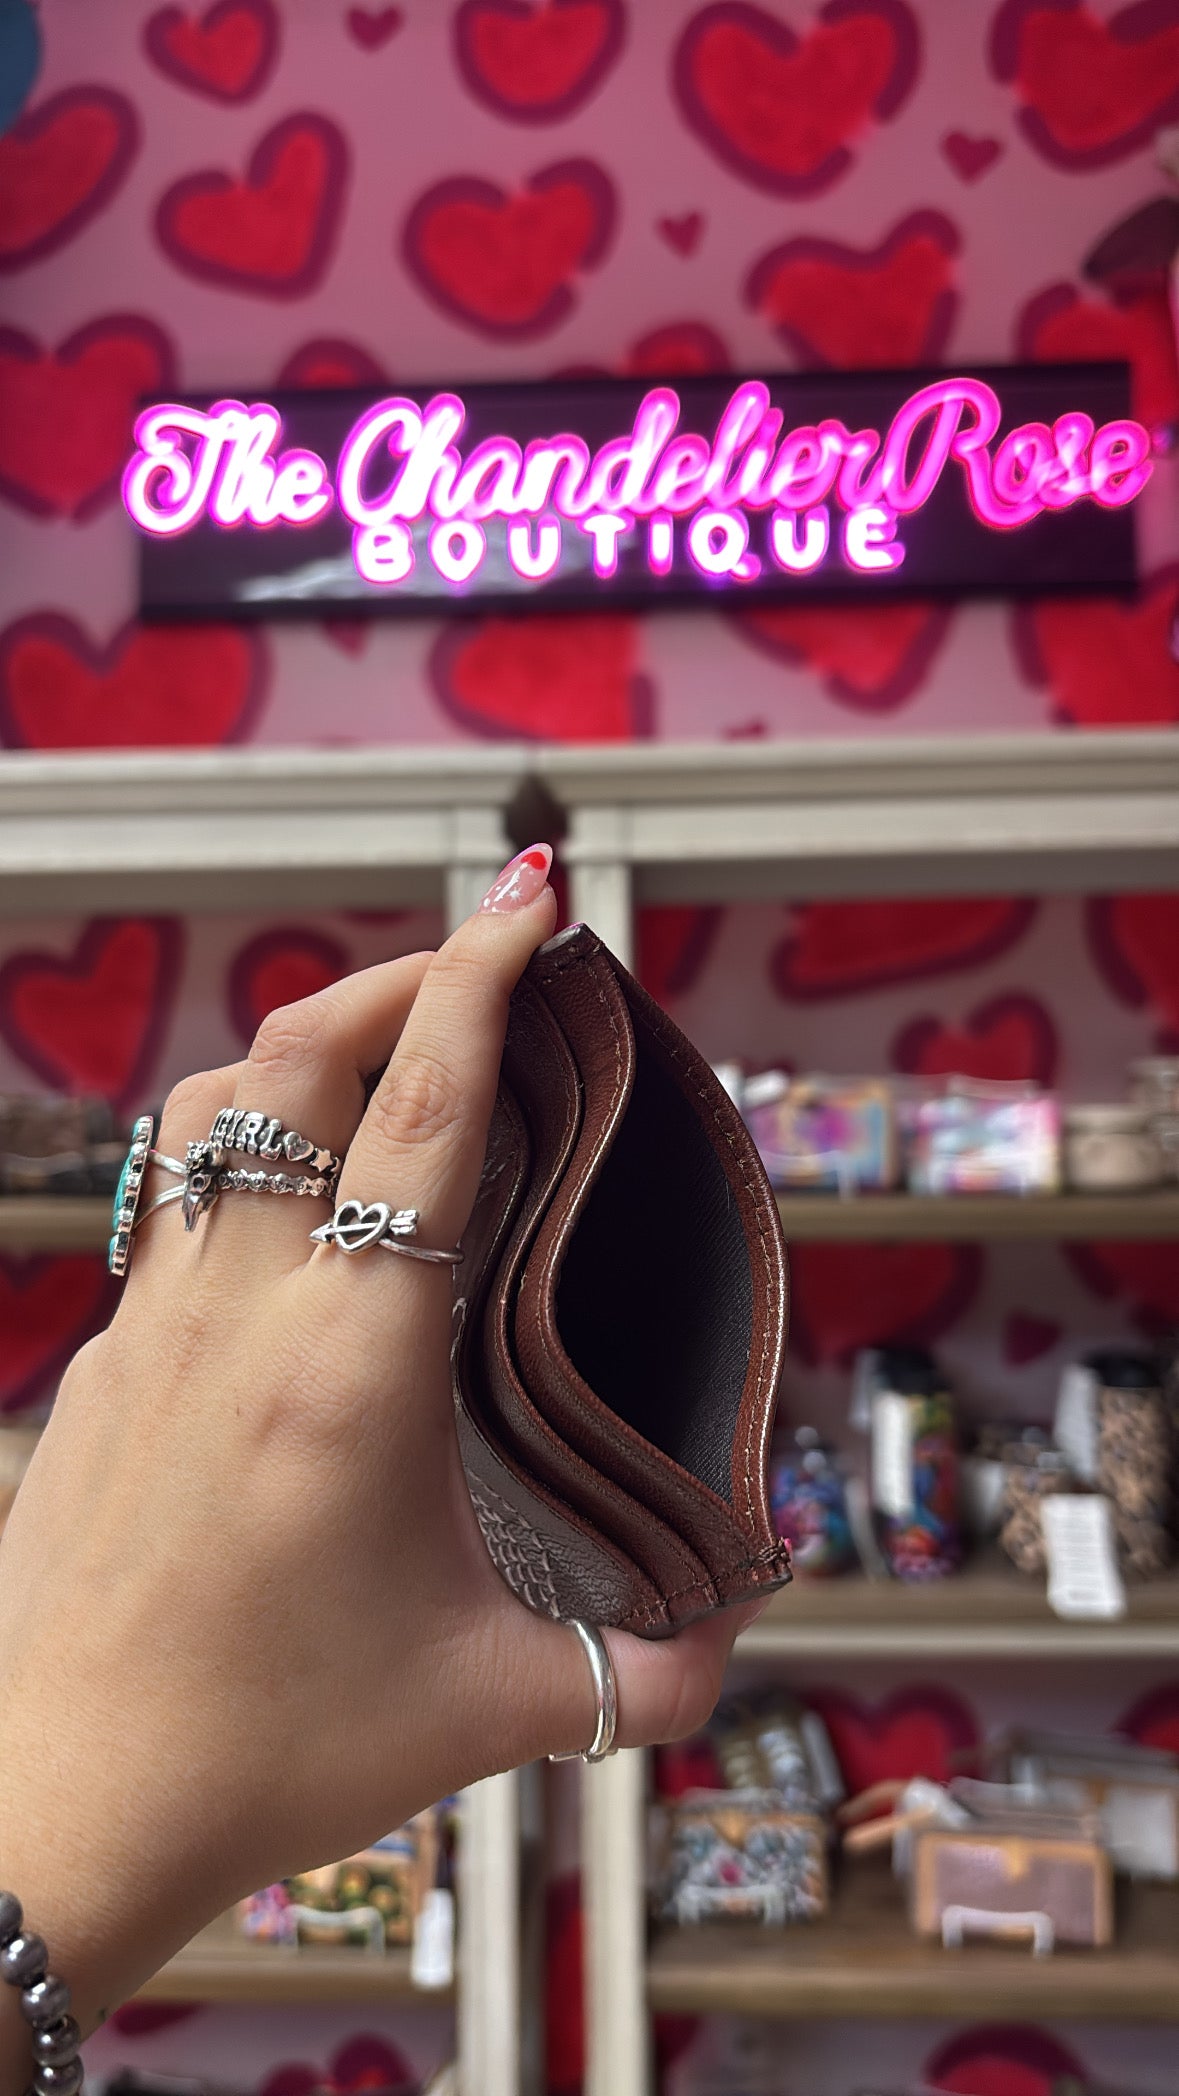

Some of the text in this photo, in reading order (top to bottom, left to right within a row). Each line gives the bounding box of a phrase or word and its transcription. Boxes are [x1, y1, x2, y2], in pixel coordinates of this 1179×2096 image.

[122, 377, 1154, 534] The Chandelier Rose
[352, 503, 905, 583] BOUTIQUE
